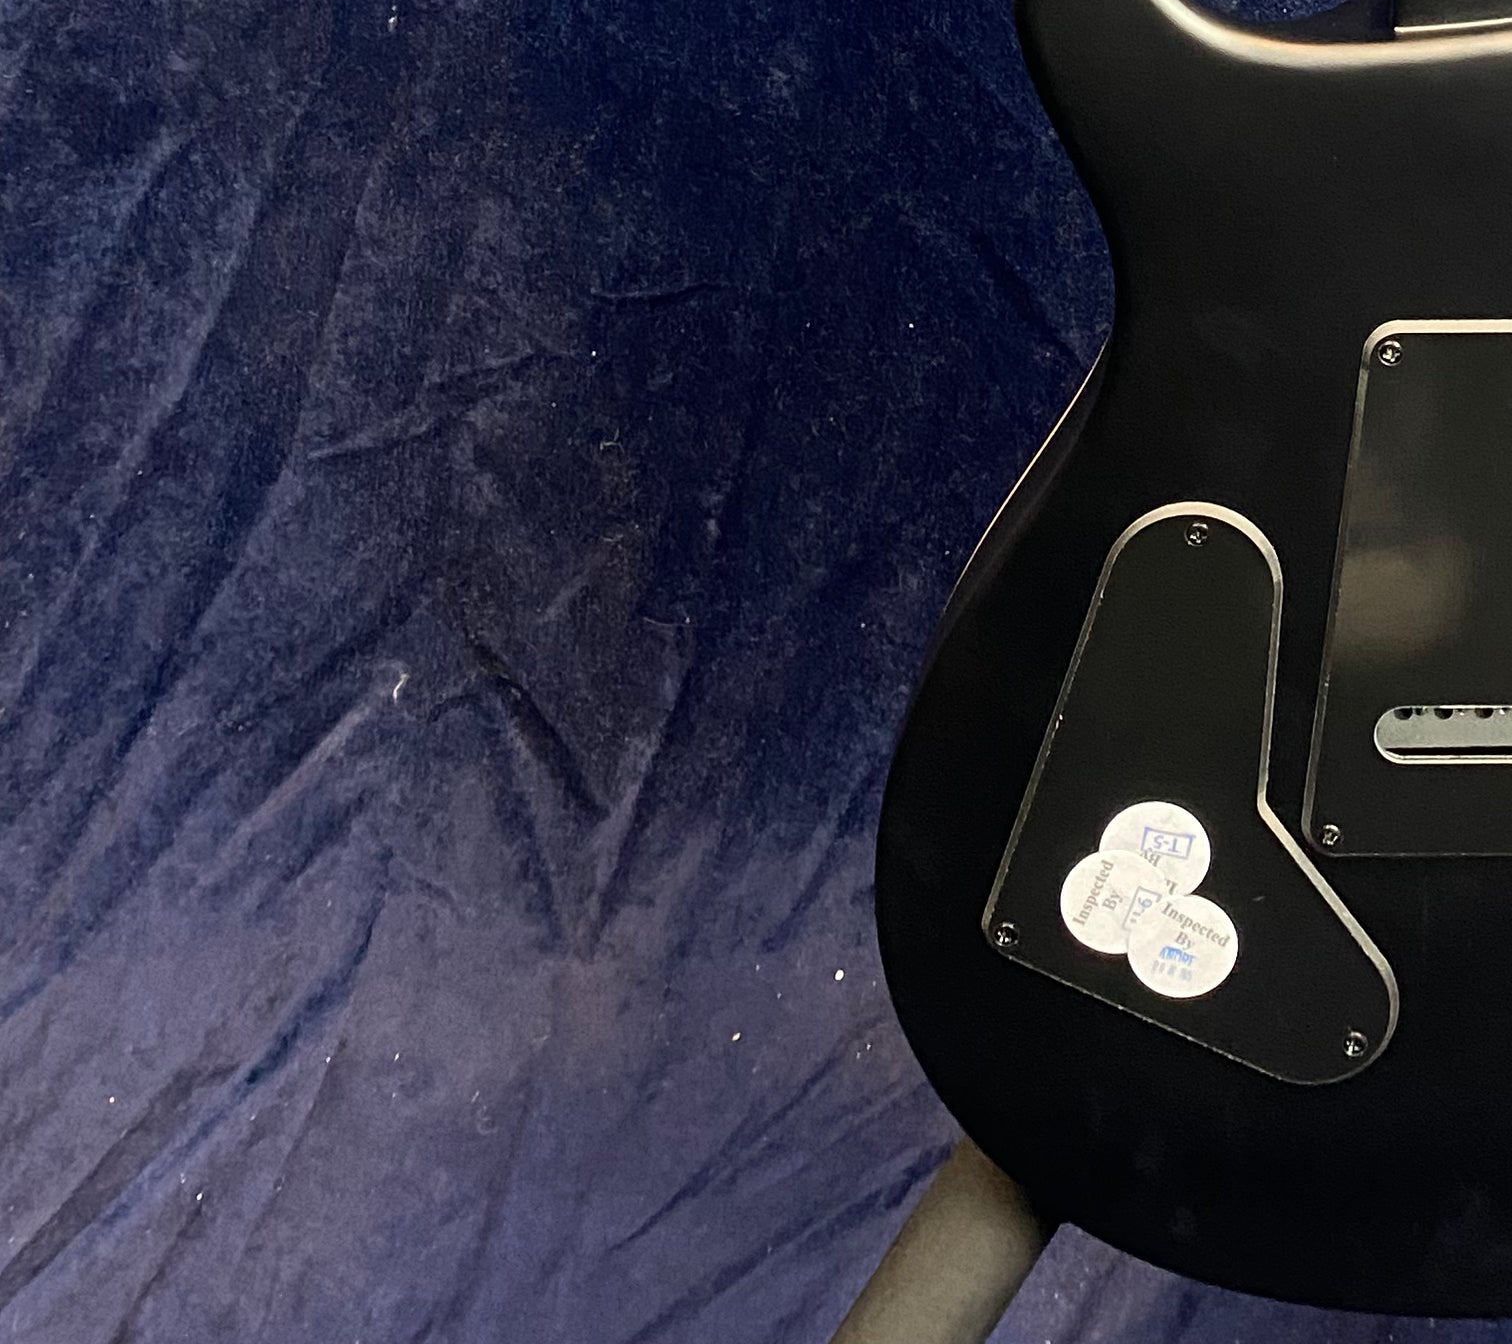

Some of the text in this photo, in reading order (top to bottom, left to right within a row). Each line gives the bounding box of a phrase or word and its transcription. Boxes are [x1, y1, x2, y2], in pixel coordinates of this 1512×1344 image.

[1072, 859, 1115, 927] Inspected
[1102, 889, 1124, 912] By
[1160, 901, 1231, 948] Inspected
[1175, 931, 1197, 951] By
